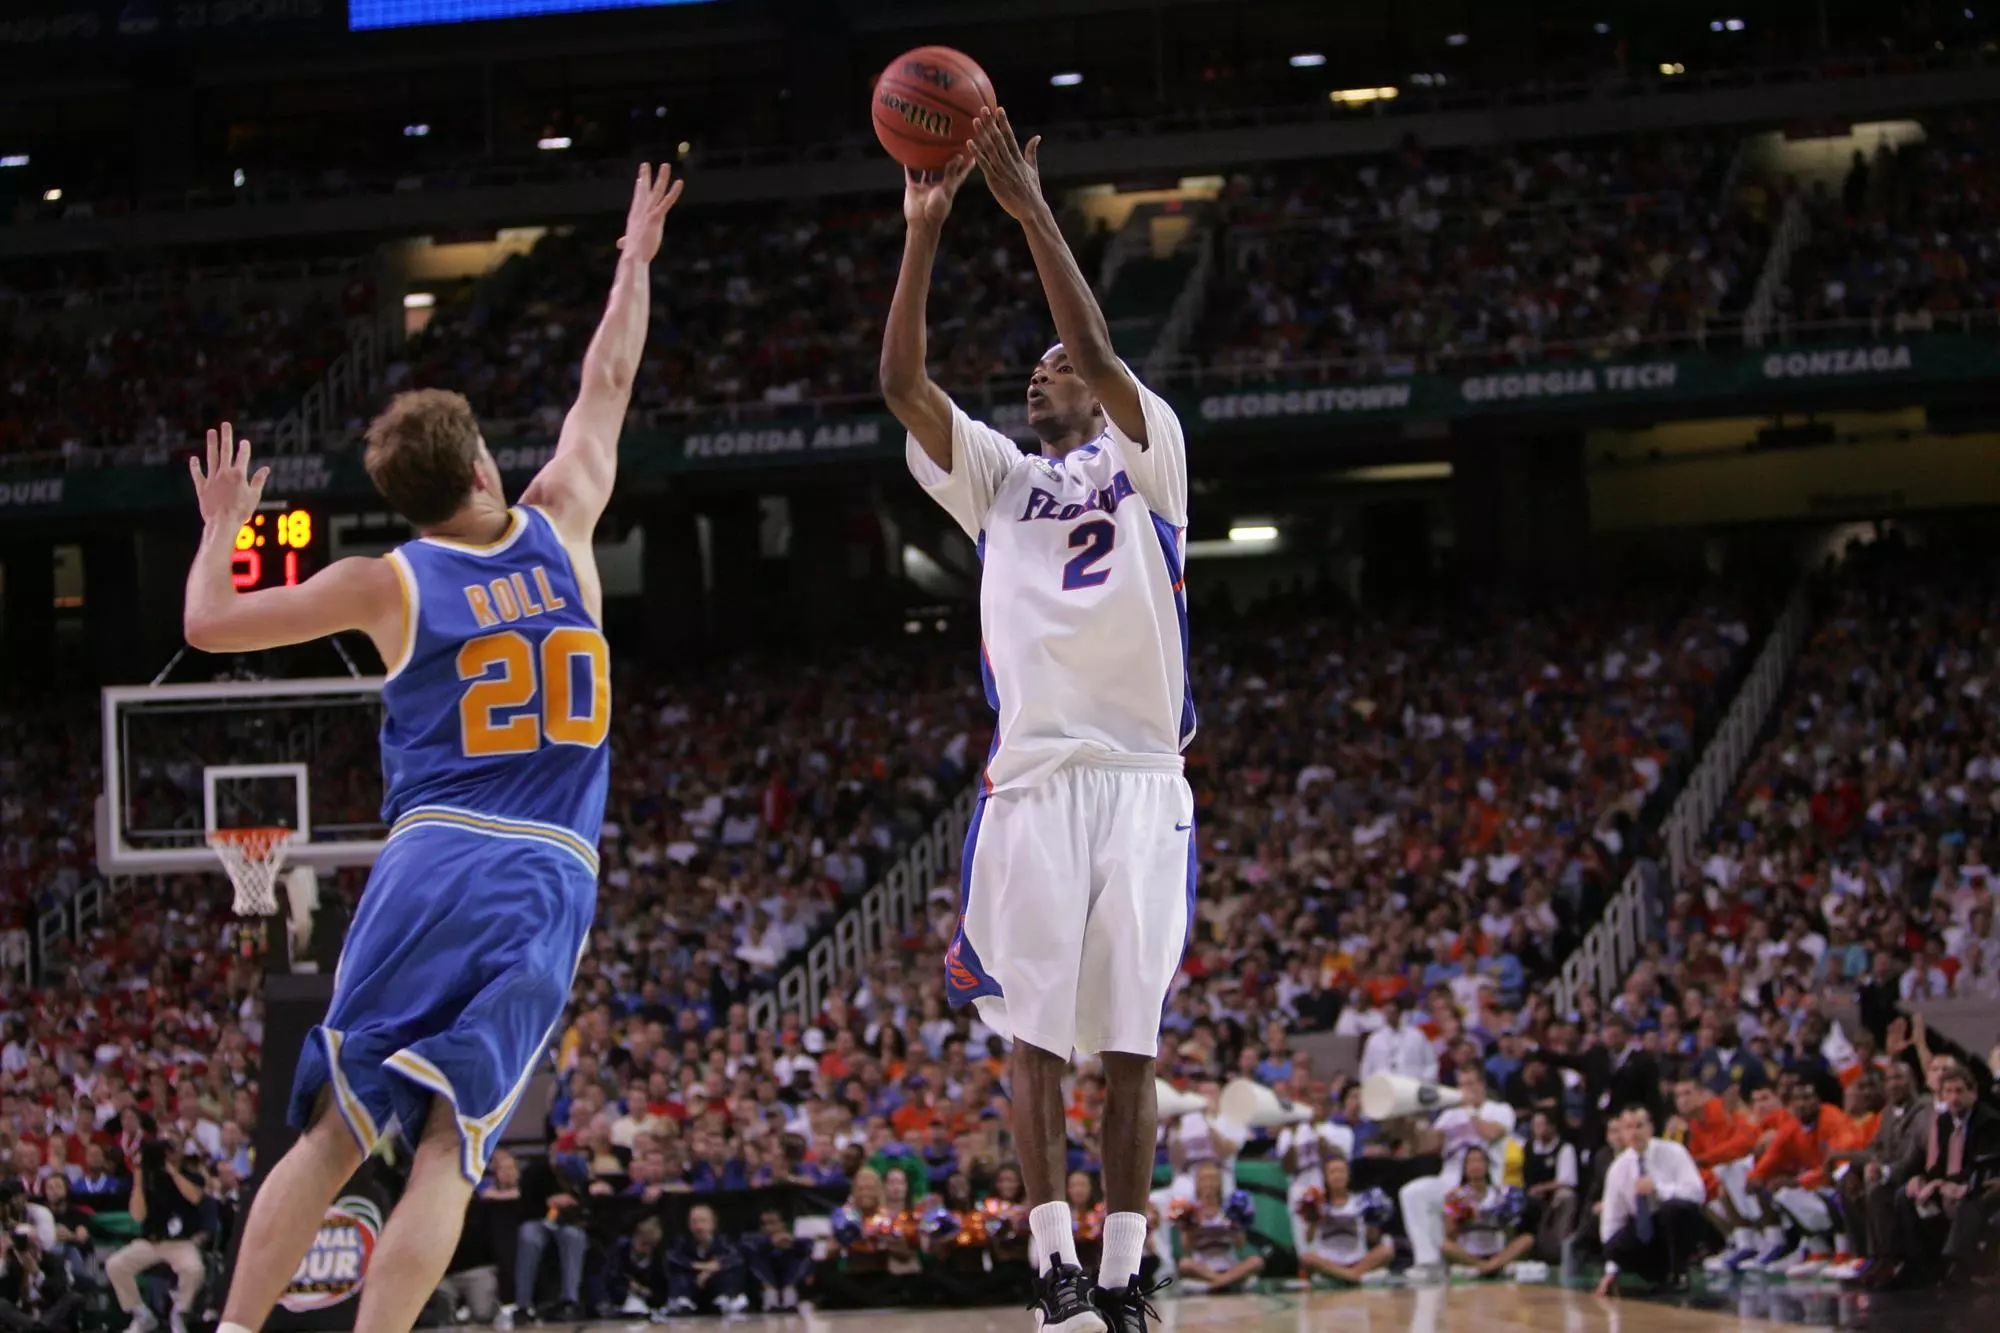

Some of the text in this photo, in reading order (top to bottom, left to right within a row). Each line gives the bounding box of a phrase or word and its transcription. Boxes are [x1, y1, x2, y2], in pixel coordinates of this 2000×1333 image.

[1460, 362, 1679, 405] GEORGIA TECH
[1762, 345, 1912, 379] GONZAGA
[1200, 384, 1411, 423] GEORGETOWN
[683, 421, 880, 459] FLORIDA A&M
[1062, 518, 1116, 591] 2
[463, 564, 567, 629] ROLL
[455, 626, 612, 757] 20
